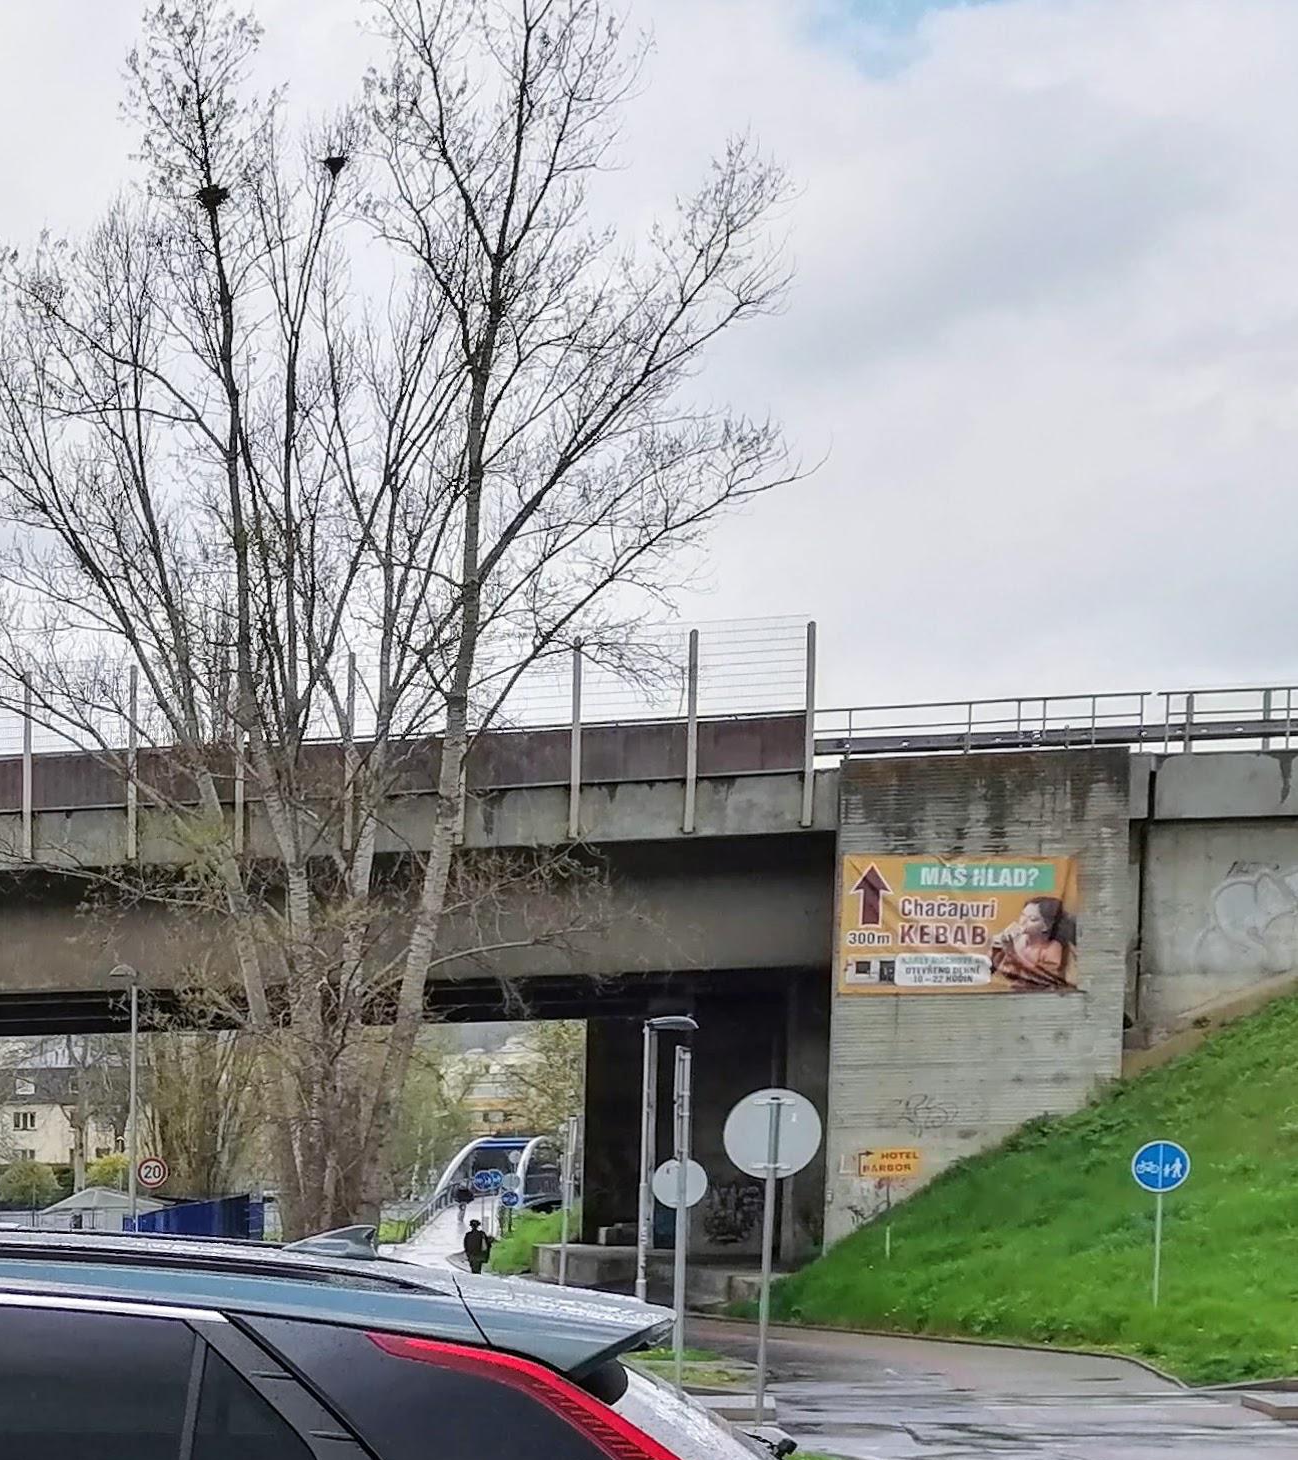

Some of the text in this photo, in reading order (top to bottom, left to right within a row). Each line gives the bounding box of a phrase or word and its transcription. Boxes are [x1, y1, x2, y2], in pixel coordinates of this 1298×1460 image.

[972, 866, 1040, 887] HLAD?
[901, 897, 996, 920] Chačapuri
[900, 925, 987, 946] KEBAB
[880, 1151, 920, 1160] HOTEL
[144, 1165, 162, 1179] 20
